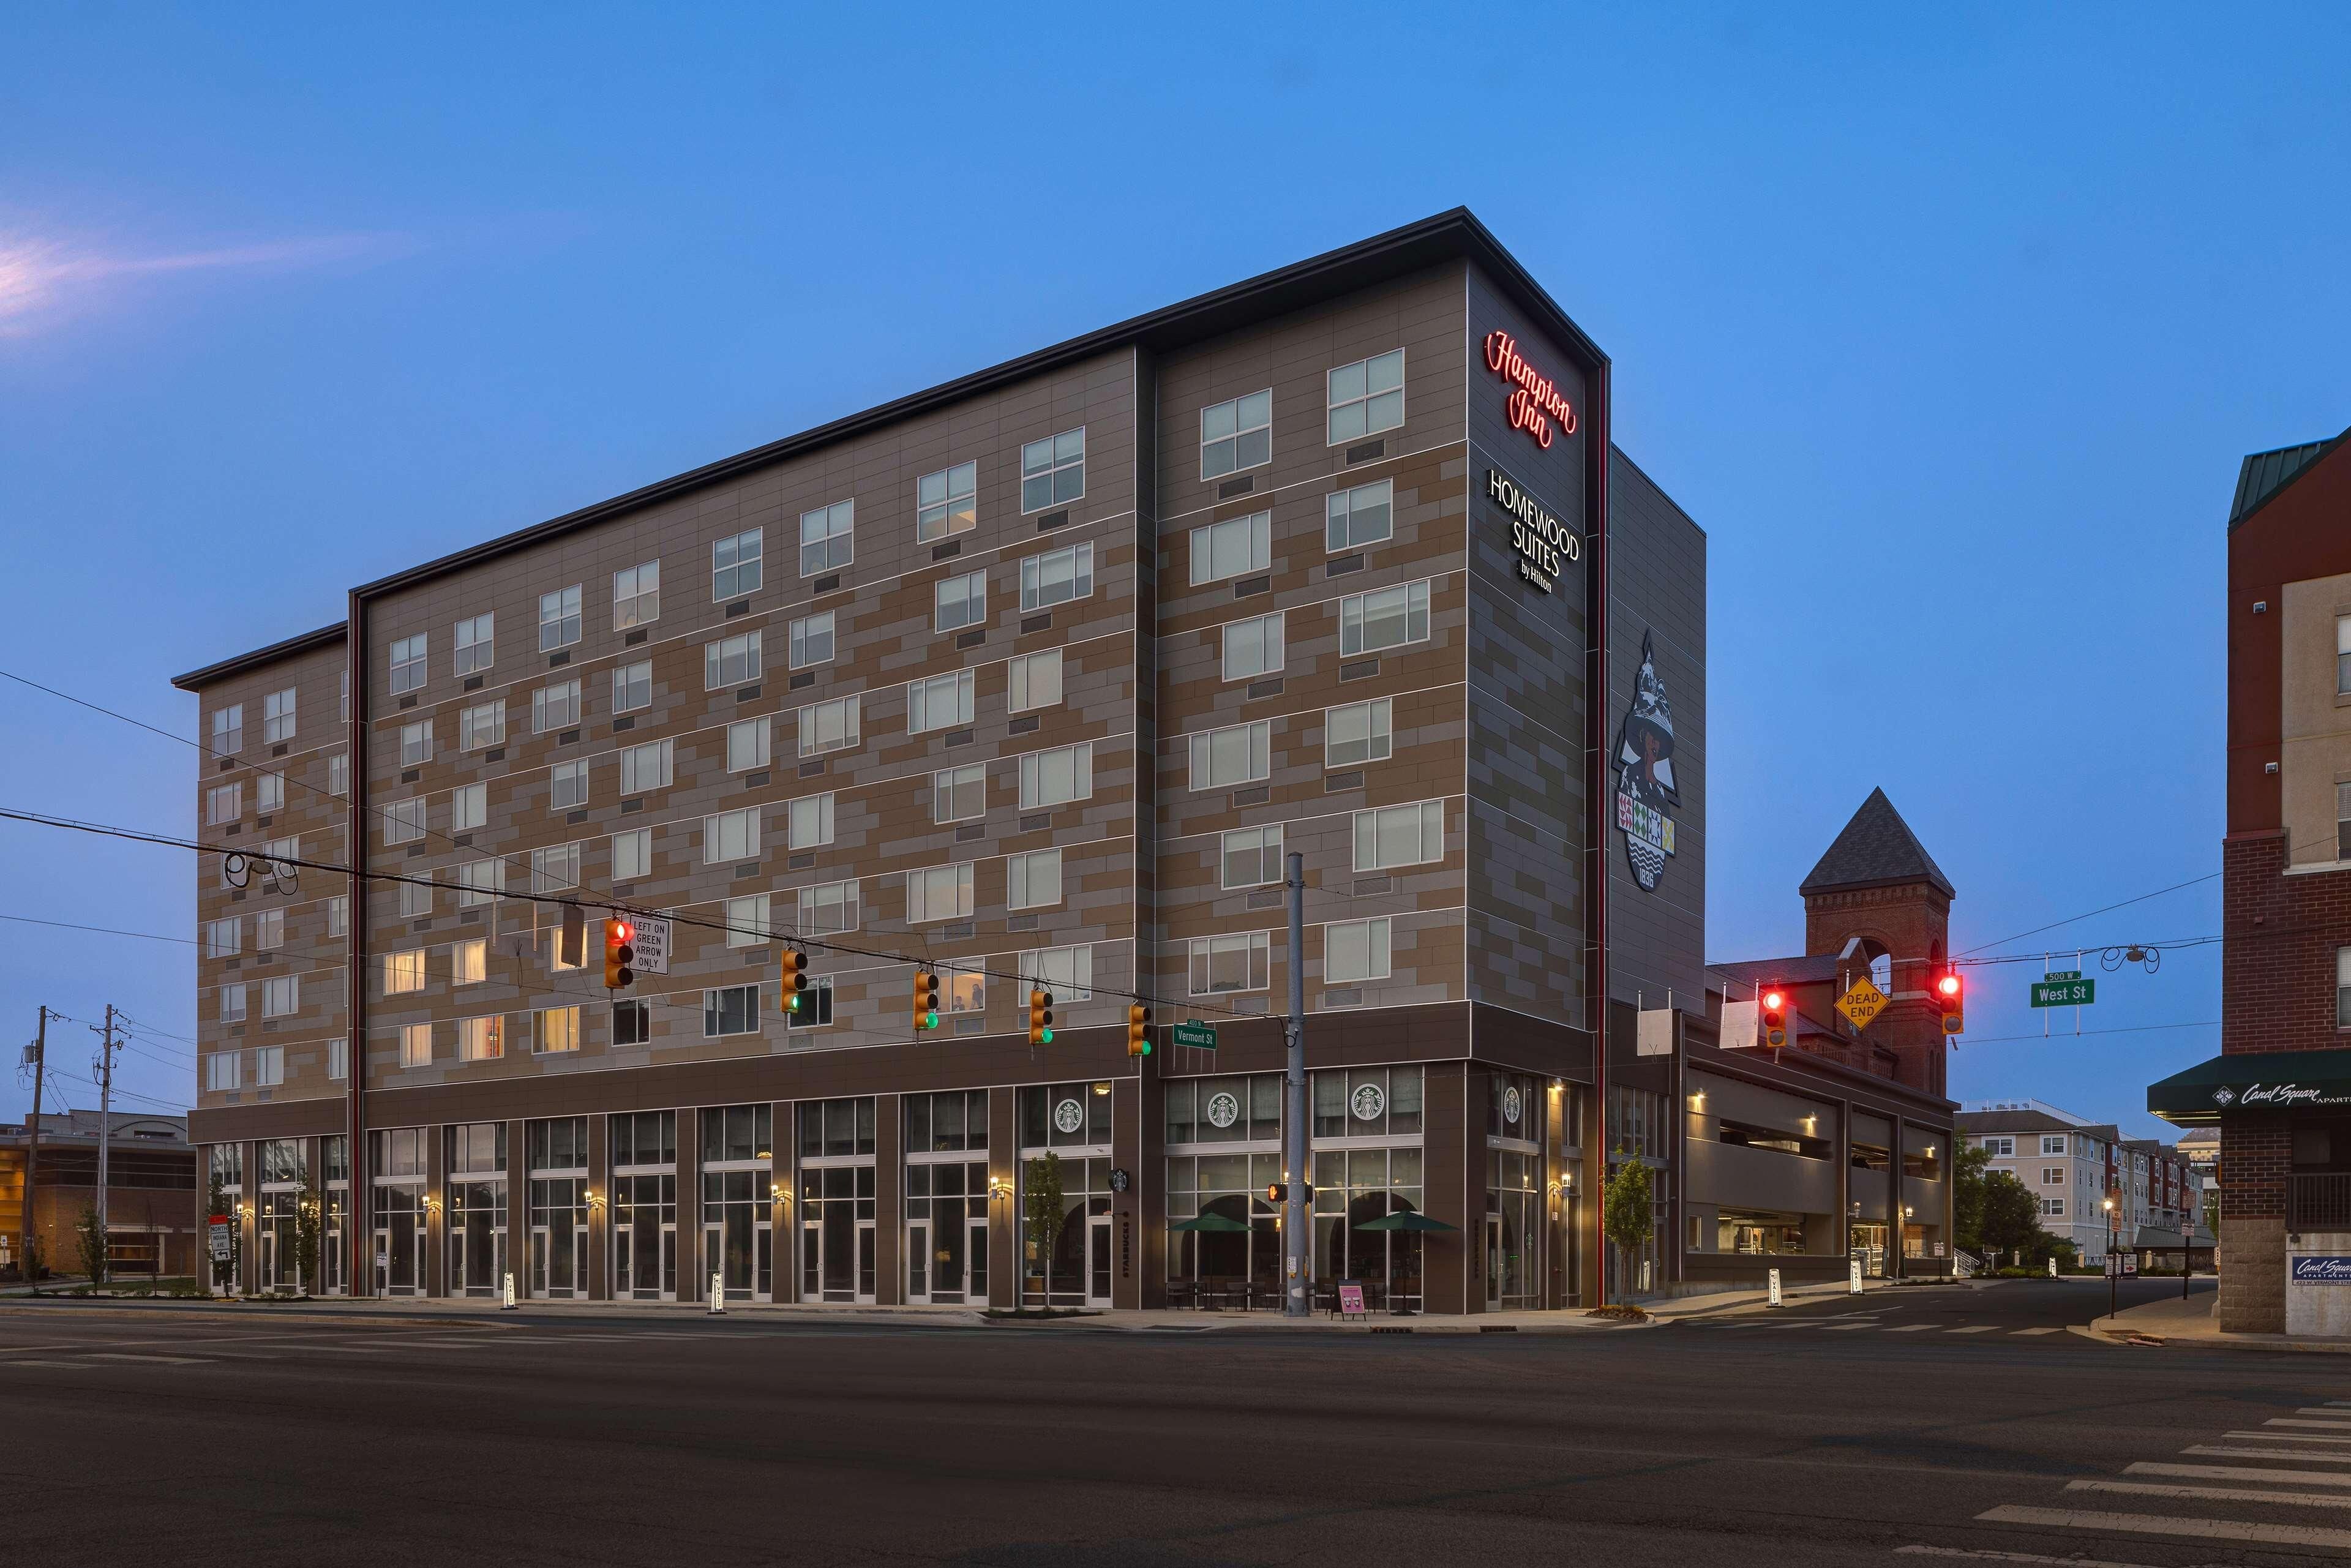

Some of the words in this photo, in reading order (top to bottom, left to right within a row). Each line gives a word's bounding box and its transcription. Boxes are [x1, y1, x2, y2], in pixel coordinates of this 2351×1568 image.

[1487, 331, 1576, 433] Hampton
[1510, 389, 1551, 448] Inn
[1490, 469, 1579, 561] HOMEWOOD
[1513, 521, 1559, 577] SUITES
[1521, 558, 1530, 579] by
[1531, 566, 1551, 593] Hilton
[634, 921, 651, 931] LEFT
[654, 925, 664, 934] ON
[637, 933, 661, 945] GREEN
[636, 945, 661, 956] ARROW
[639, 957, 658, 967] ONLY
[1847, 992, 1879, 1005] DEAD
[2039, 987, 2068, 1001] West
[2072, 986, 2086, 999] St
[1851, 1006, 1874, 1017] END
[1178, 1030, 1204, 1043] Vermont
[1206, 1033, 1212, 1044] St
[2241, 1083, 2281, 1104] Canal
[2274, 1084, 2320, 1105] Square
[2297, 1259, 2327, 1274] Canal
